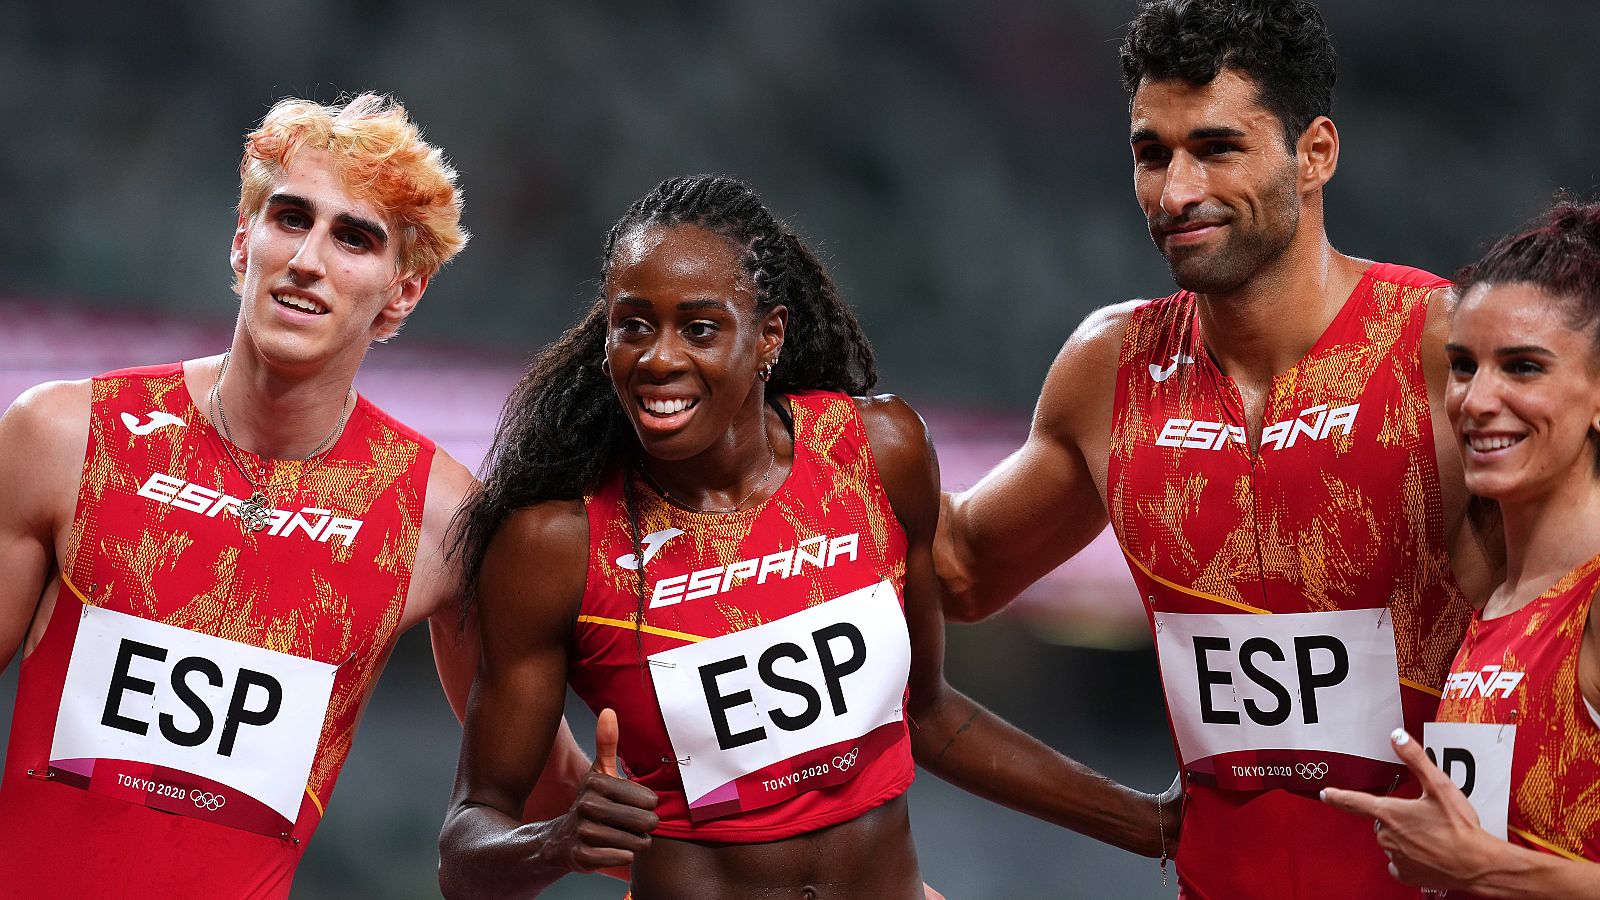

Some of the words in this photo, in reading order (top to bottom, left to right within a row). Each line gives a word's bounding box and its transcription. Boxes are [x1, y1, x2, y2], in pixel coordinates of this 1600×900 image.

[1155, 403, 1361, 451] ESPAÑA
[136, 472, 363, 547] ESPAÑA
[648, 533, 860, 609] ESPAÑA
[100, 637, 283, 757] ESP
[697, 622, 867, 751] ESP
[1192, 635, 1350, 726] ESP
[117, 773, 156, 793] TOKYO
[156, 783, 186, 800] 2020
[762, 773, 800, 792] TOKYO
[801, 763, 829, 780] 2020
[1231, 765, 1265, 777] TOKYO
[1266, 765, 1292, 777] 2020
